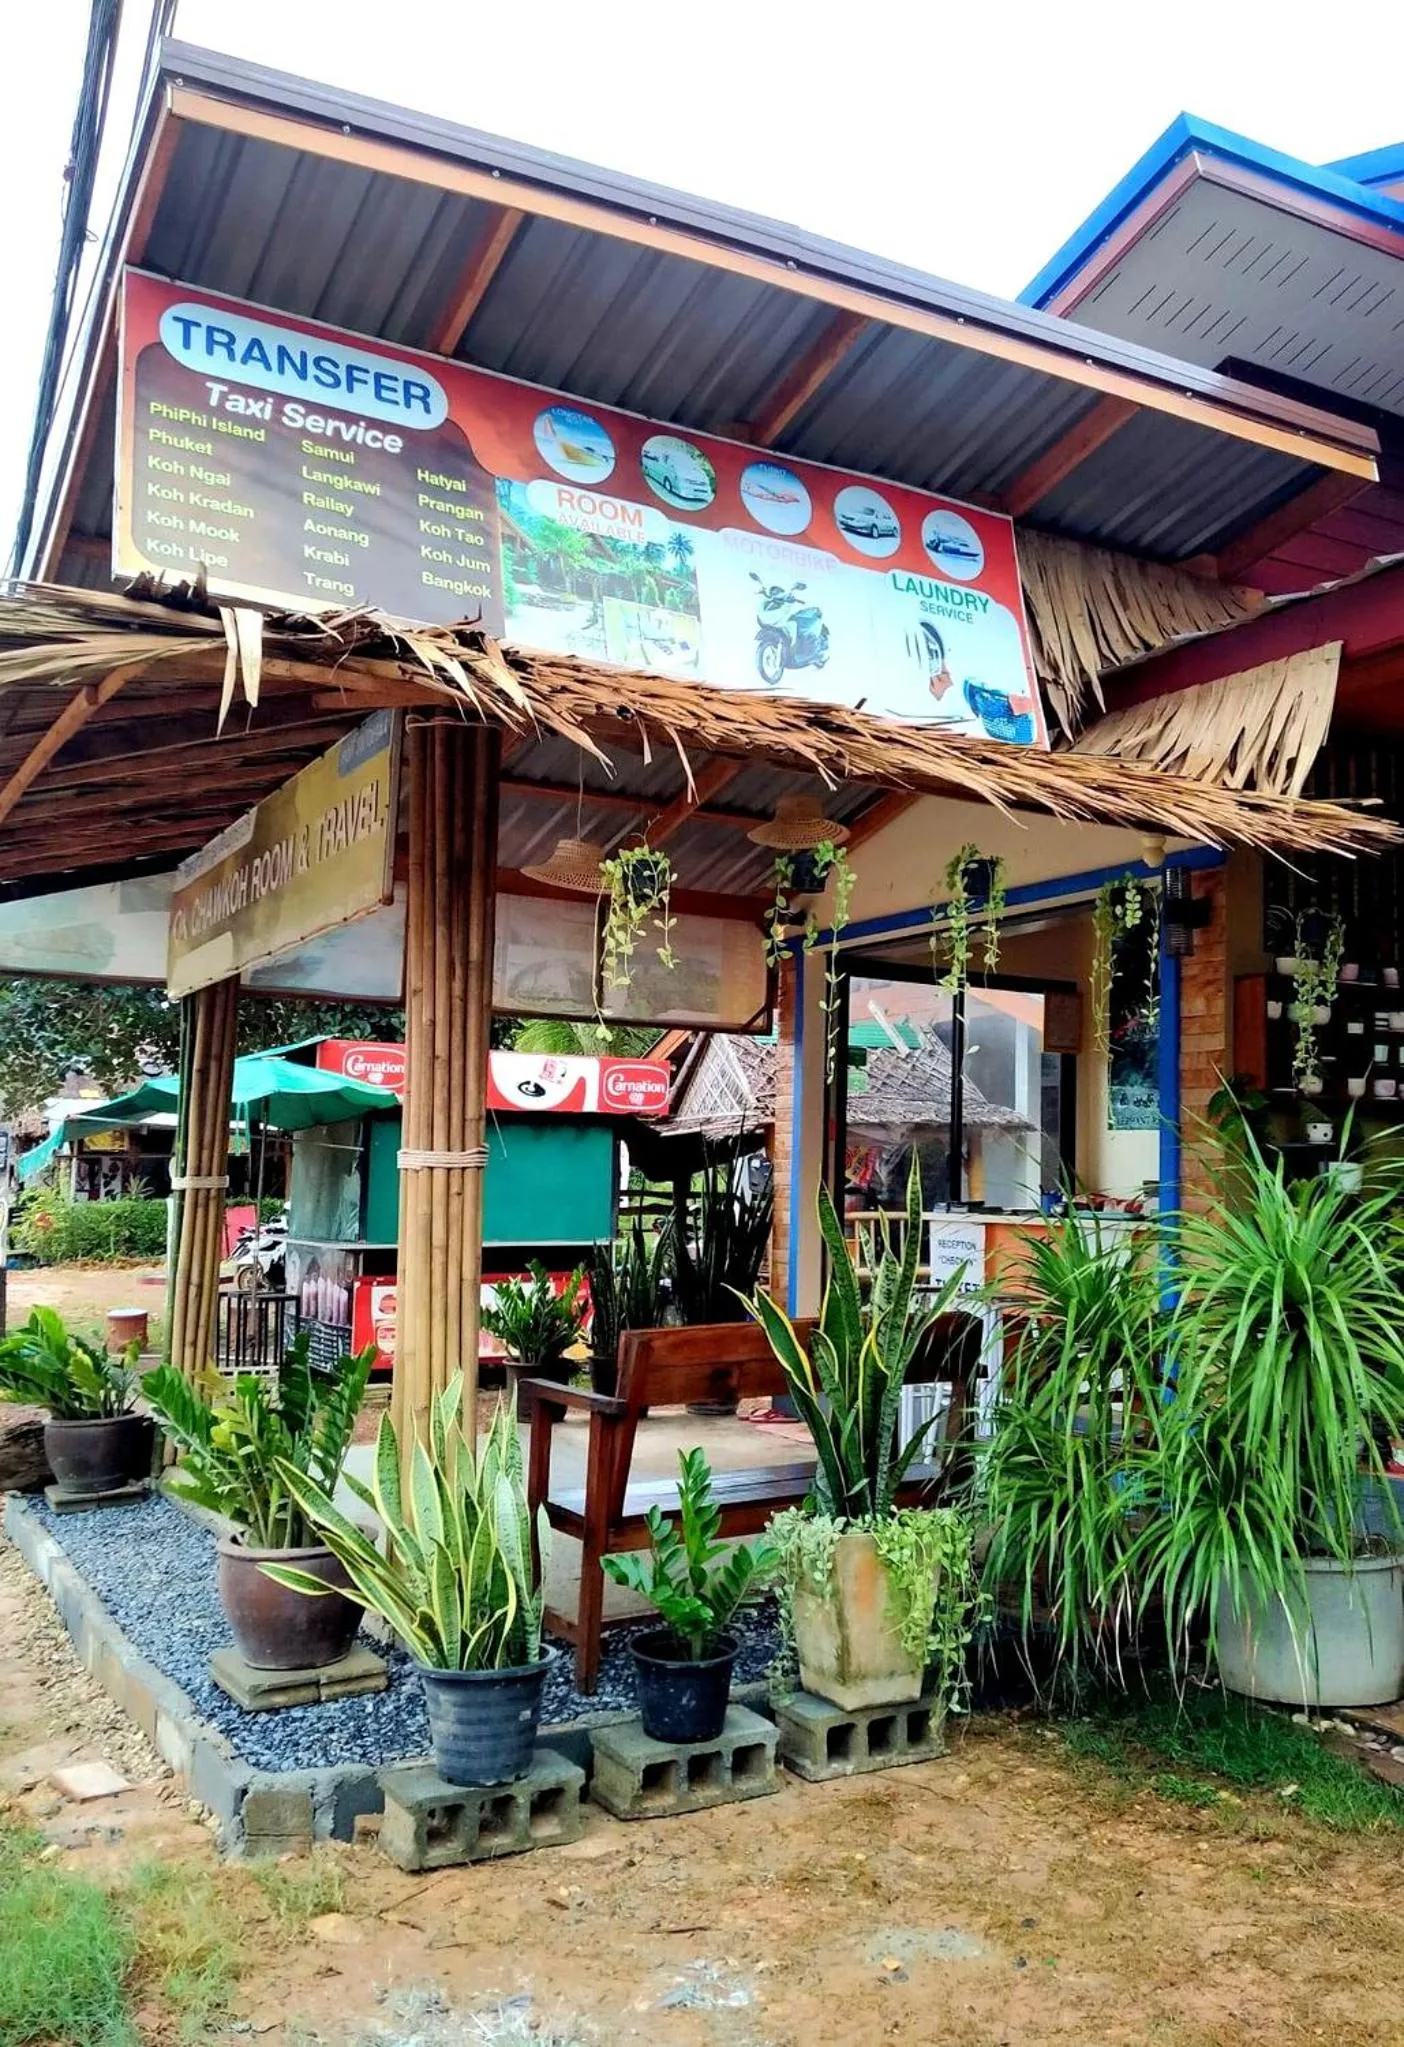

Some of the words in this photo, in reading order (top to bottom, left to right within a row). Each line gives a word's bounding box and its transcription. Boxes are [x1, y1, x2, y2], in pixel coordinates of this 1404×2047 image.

[172, 316, 431, 414] TRANSFER
[149, 402, 207, 427] PhiPhi
[212, 417, 265, 442] Island
[205, 381, 272, 420] Taxi
[282, 402, 404, 453] Service
[148, 428, 214, 456] Phuket
[301, 439, 355, 464] Samui
[147, 455, 185, 476] Koh
[189, 464, 231, 487] Ngai
[302, 465, 381, 496] Langkawi
[416, 469, 466, 492] Hatyai
[147, 482, 185, 503] Koh
[188, 491, 255, 519] Kradan
[303, 491, 354, 517] Railay
[418, 493, 484, 520] Prangan
[556, 488, 643, 528] ROOM
[146, 510, 185, 531] Koh
[188, 519, 241, 543] Mook
[303, 518, 369, 548] Aonang
[419, 519, 452, 539] Koh
[454, 528, 485, 546] Tao
[559, 513, 646, 543] AVAILABLE
[145, 537, 185, 558] Koh
[188, 546, 229, 568] Lipe
[303, 543, 351, 567] Krabi
[420, 544, 453, 564] Koh
[456, 554, 491, 573] Jum
[303, 571, 355, 597] Trang
[422, 570, 492, 599] Bangkok
[892, 572, 990, 614] LAUNDRY
[919, 600, 975, 625] SERVICE
[250, 833, 297, 901] ROOM
[298, 824, 310, 875] &
[346, 1054, 405, 1076] Carnation
[607, 1073, 666, 1096] Carnation
